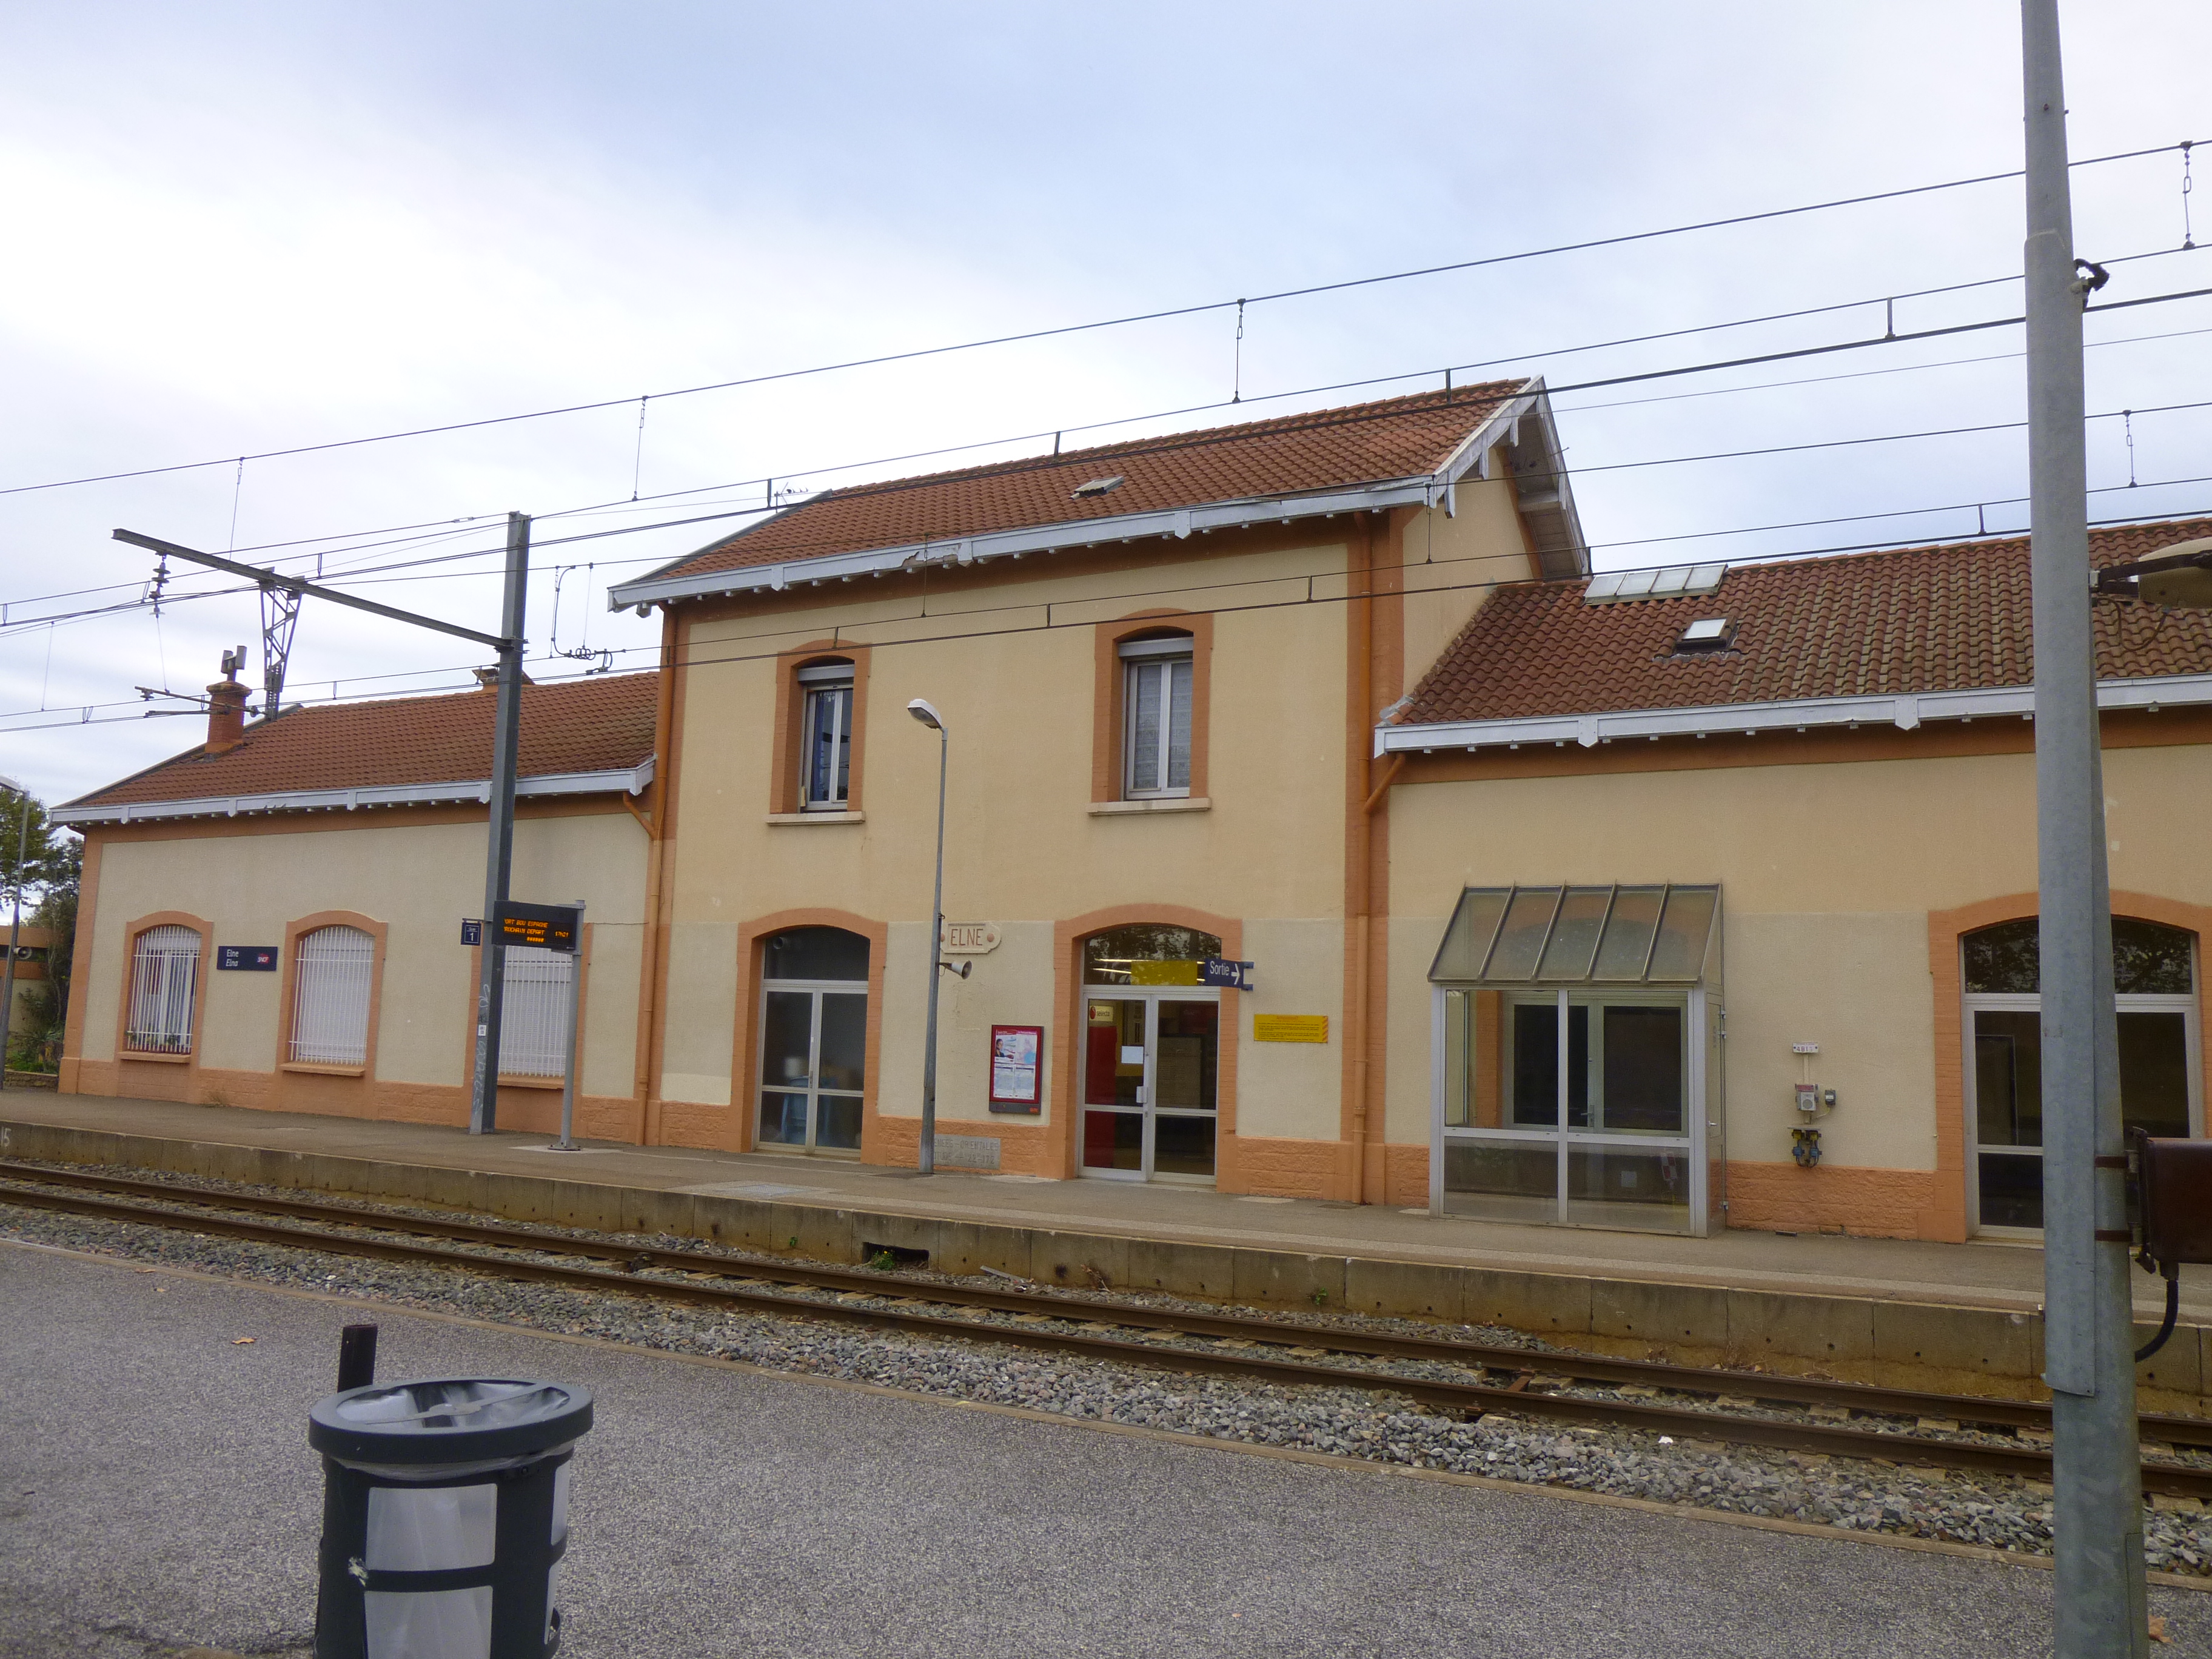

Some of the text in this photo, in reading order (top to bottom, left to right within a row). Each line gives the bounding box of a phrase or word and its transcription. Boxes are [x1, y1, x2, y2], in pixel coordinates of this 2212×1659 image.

[469, 932, 474, 942] 1
[950, 928, 984, 946] ELNE
[226, 949, 239, 957] Elne
[1210, 960, 1230, 976] Sortie
